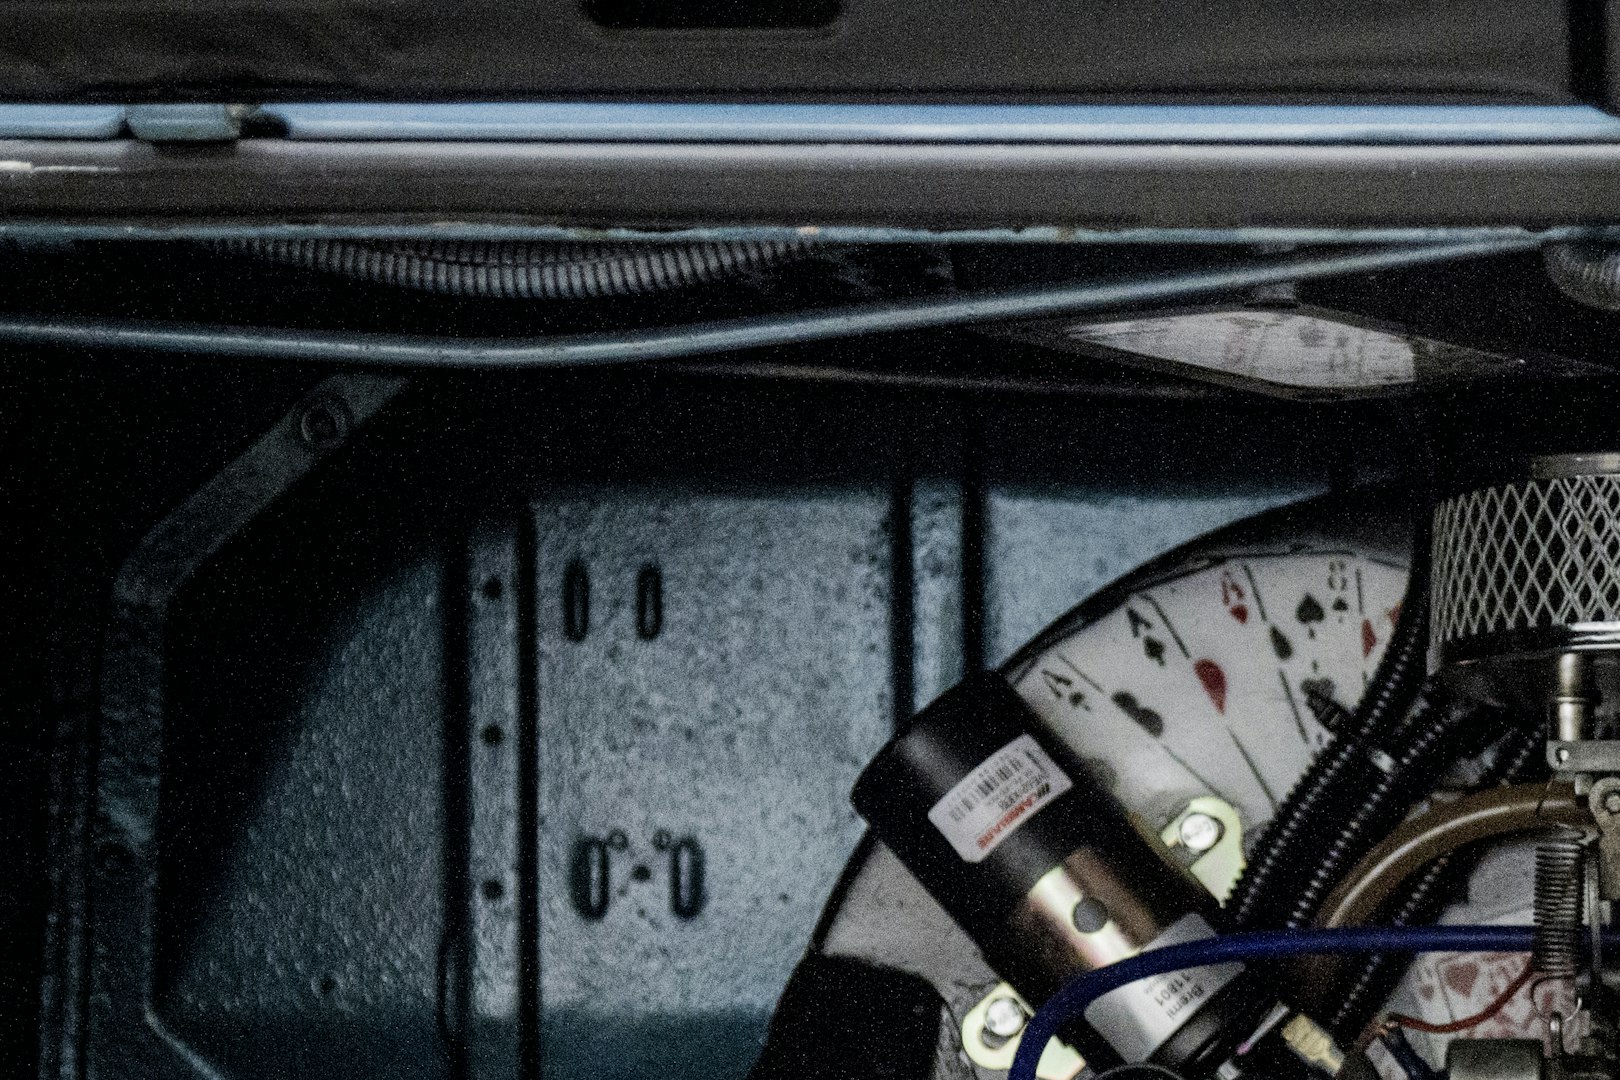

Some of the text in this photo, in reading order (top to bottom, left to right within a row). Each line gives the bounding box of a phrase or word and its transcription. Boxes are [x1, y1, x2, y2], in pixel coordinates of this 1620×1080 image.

[1222, 570, 1245, 606] A
[1127, 604, 1152, 637] A
[1042, 669, 1072, 699] A
[1166, 983, 1204, 1020] Bremi
